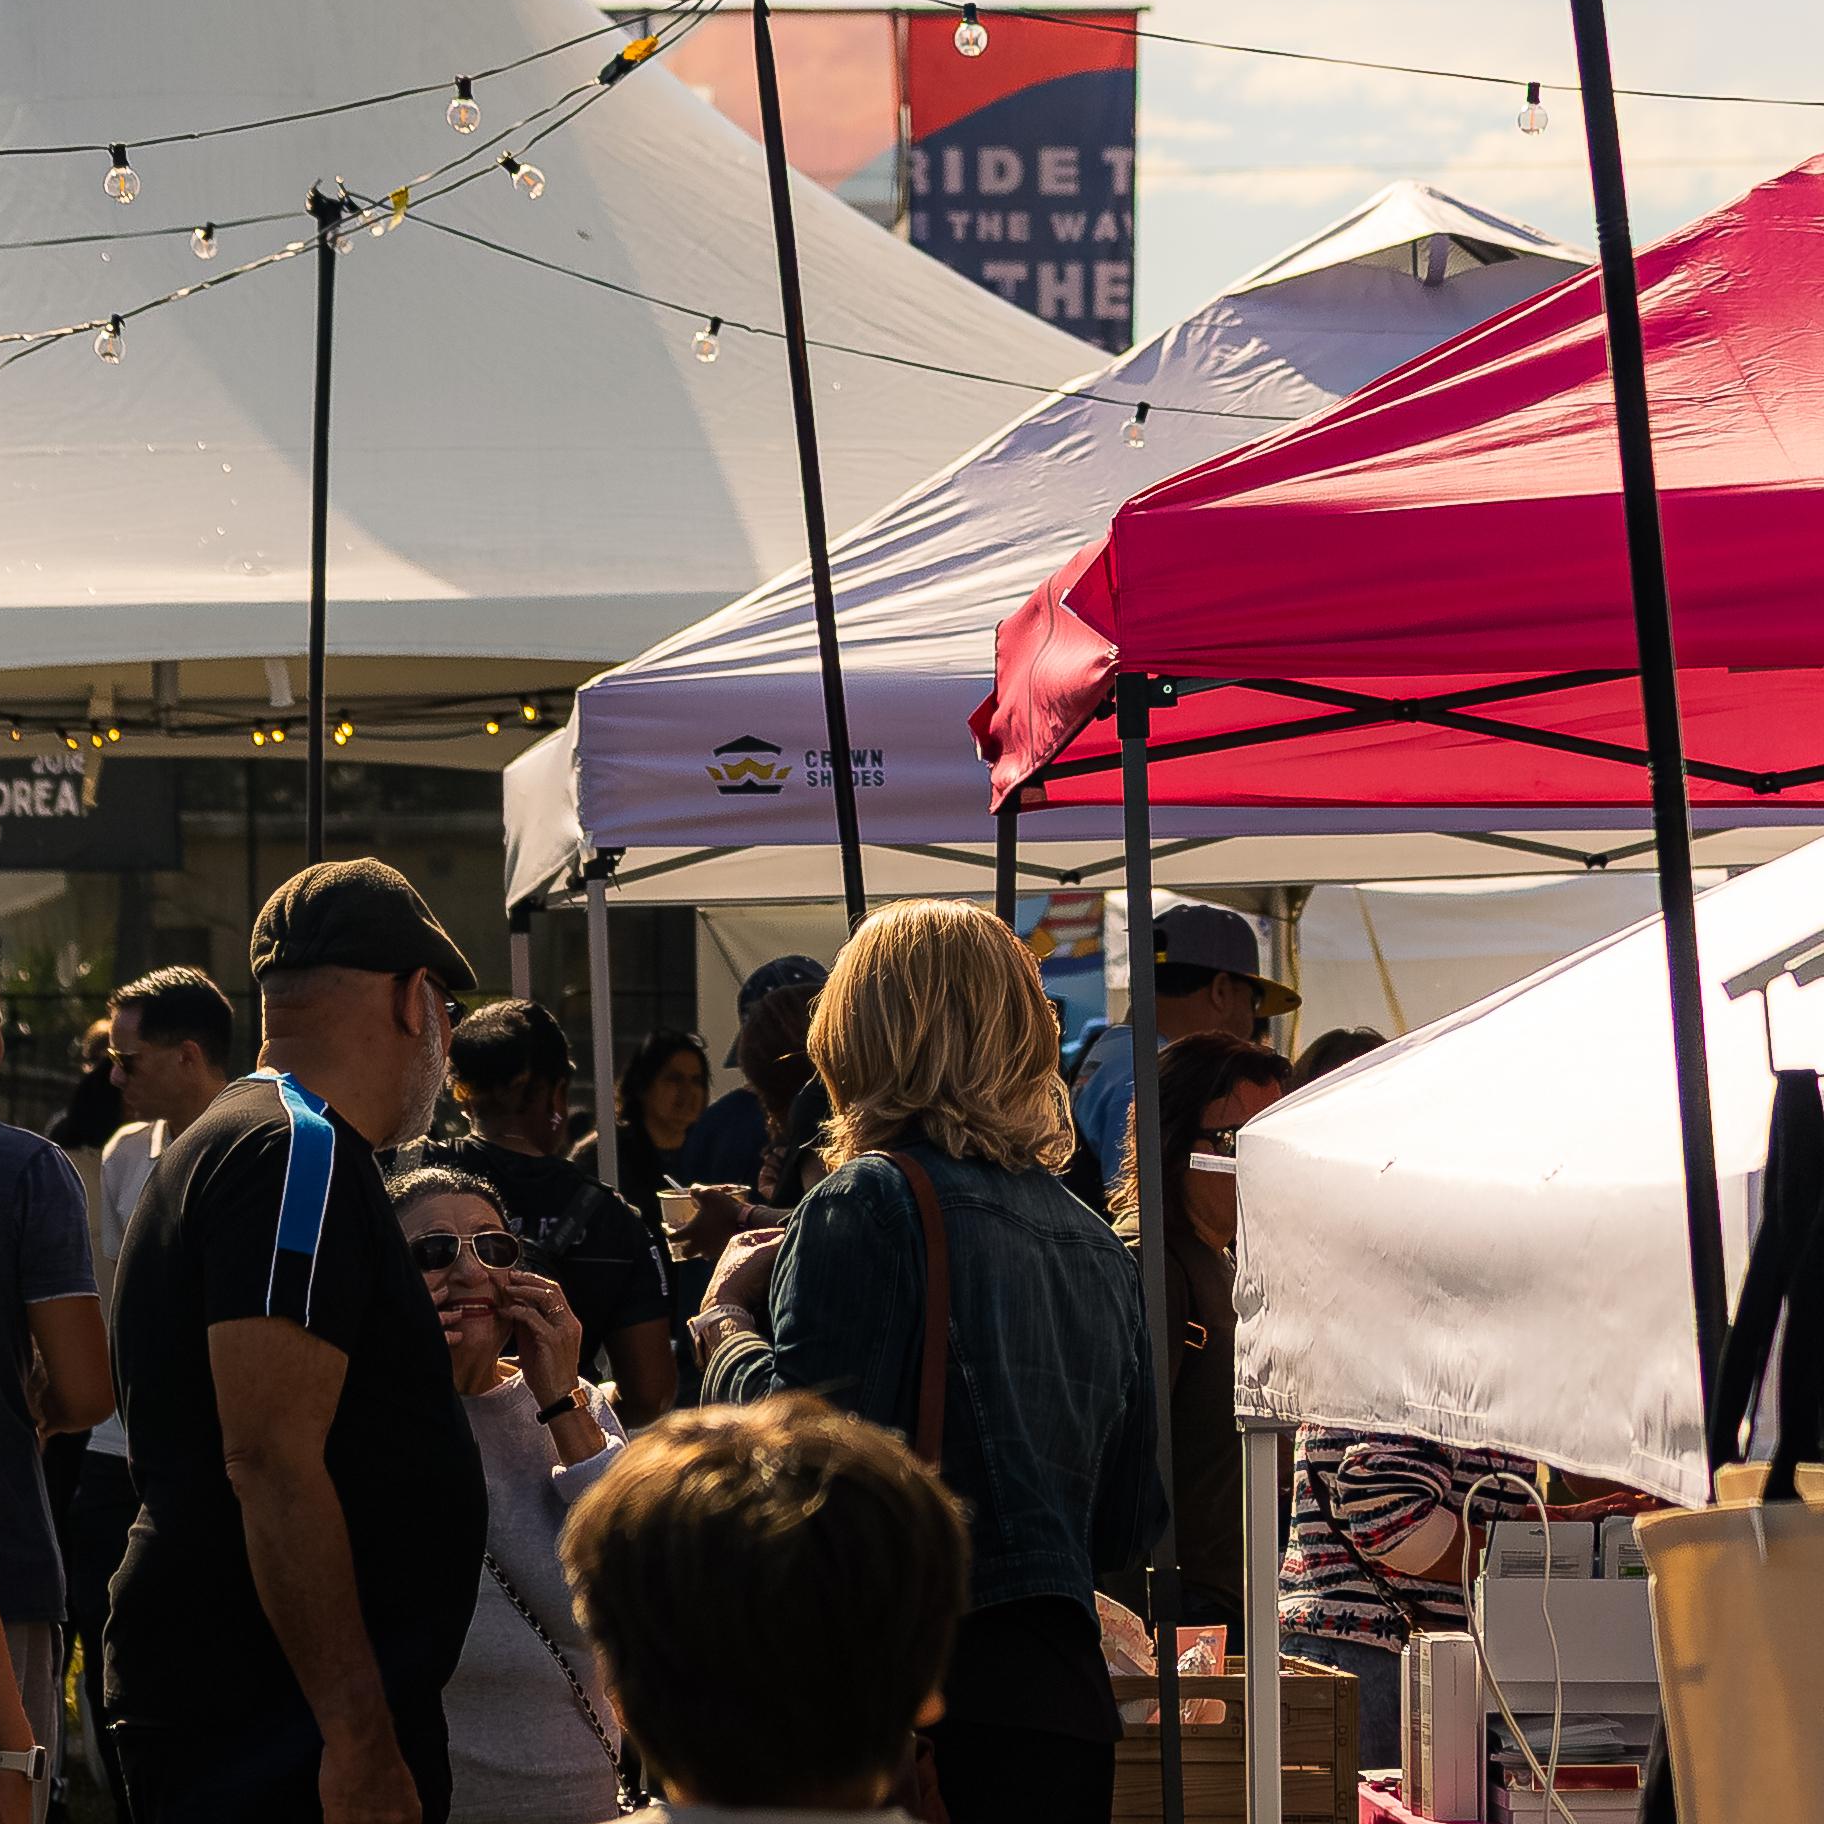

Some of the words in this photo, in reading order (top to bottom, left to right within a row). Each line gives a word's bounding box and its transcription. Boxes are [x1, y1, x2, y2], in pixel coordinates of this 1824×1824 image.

[946, 210, 1030, 242] THE
[982, 260, 1131, 320] THE
[805, 750, 884, 768] CRWN
[806, 770, 885, 788] SHDES
